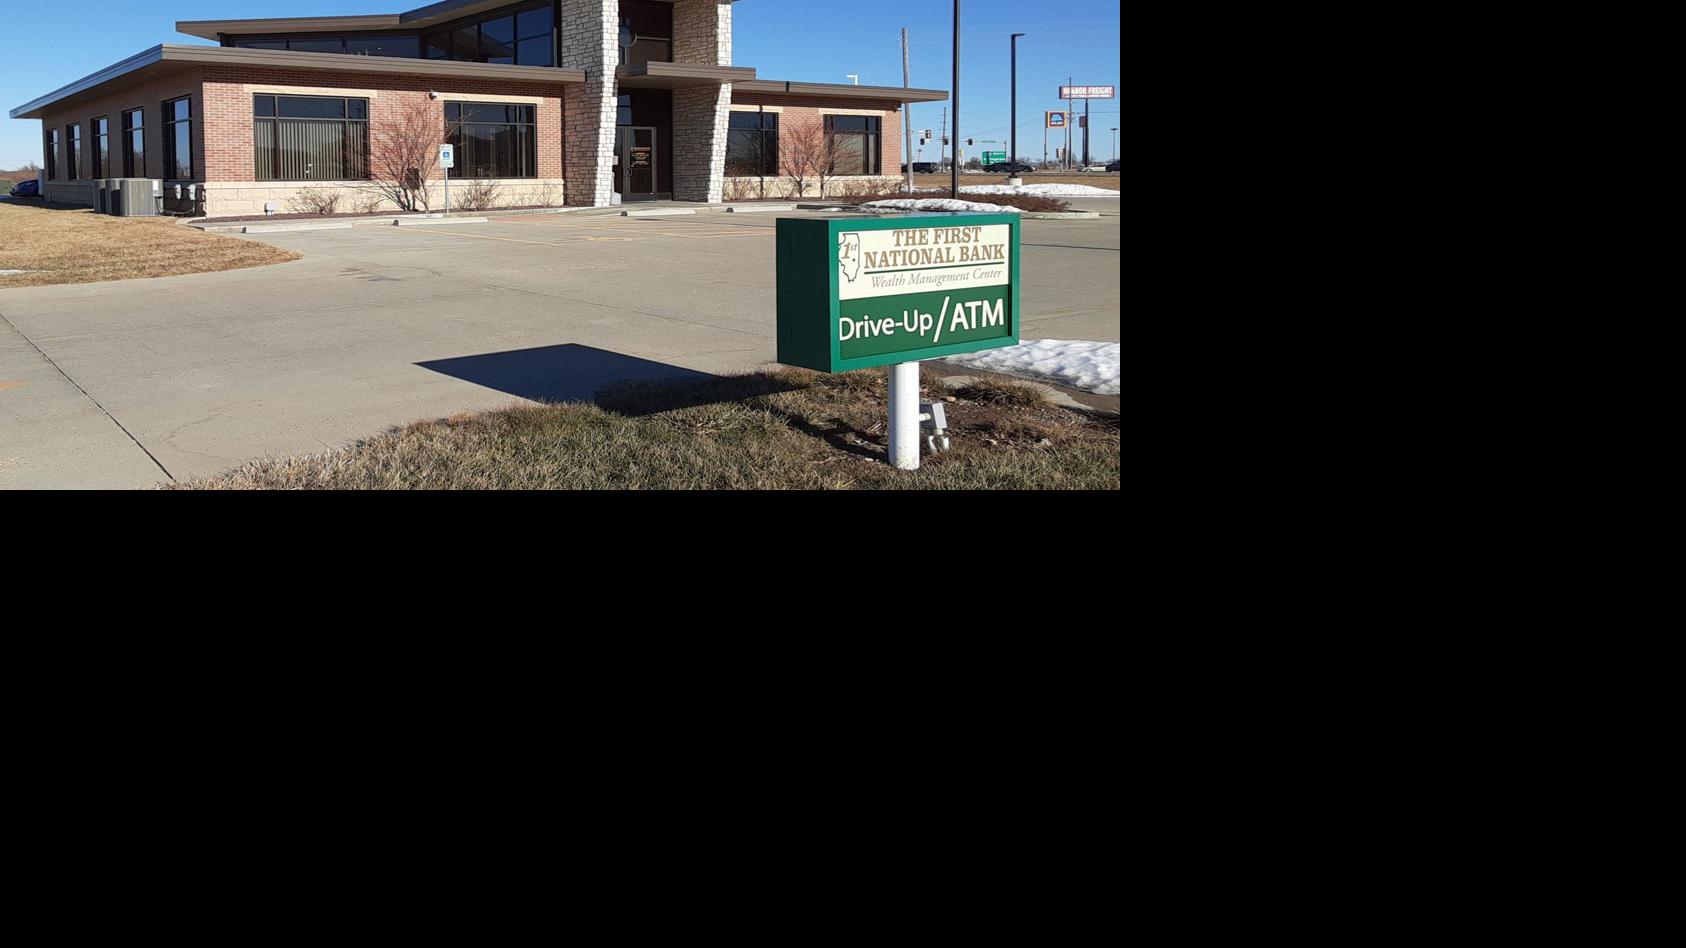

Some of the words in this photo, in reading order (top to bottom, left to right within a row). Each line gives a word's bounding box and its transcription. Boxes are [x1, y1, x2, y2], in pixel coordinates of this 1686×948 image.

[892, 230, 929, 247] THE
[933, 227, 982, 245] FIRST
[864, 246, 955, 269] NATIONAL
[959, 244, 1005, 262] BANK
[871, 274, 905, 288] Wealth
[907, 271, 970, 287] Management
[972, 268, 1003, 280] Center
